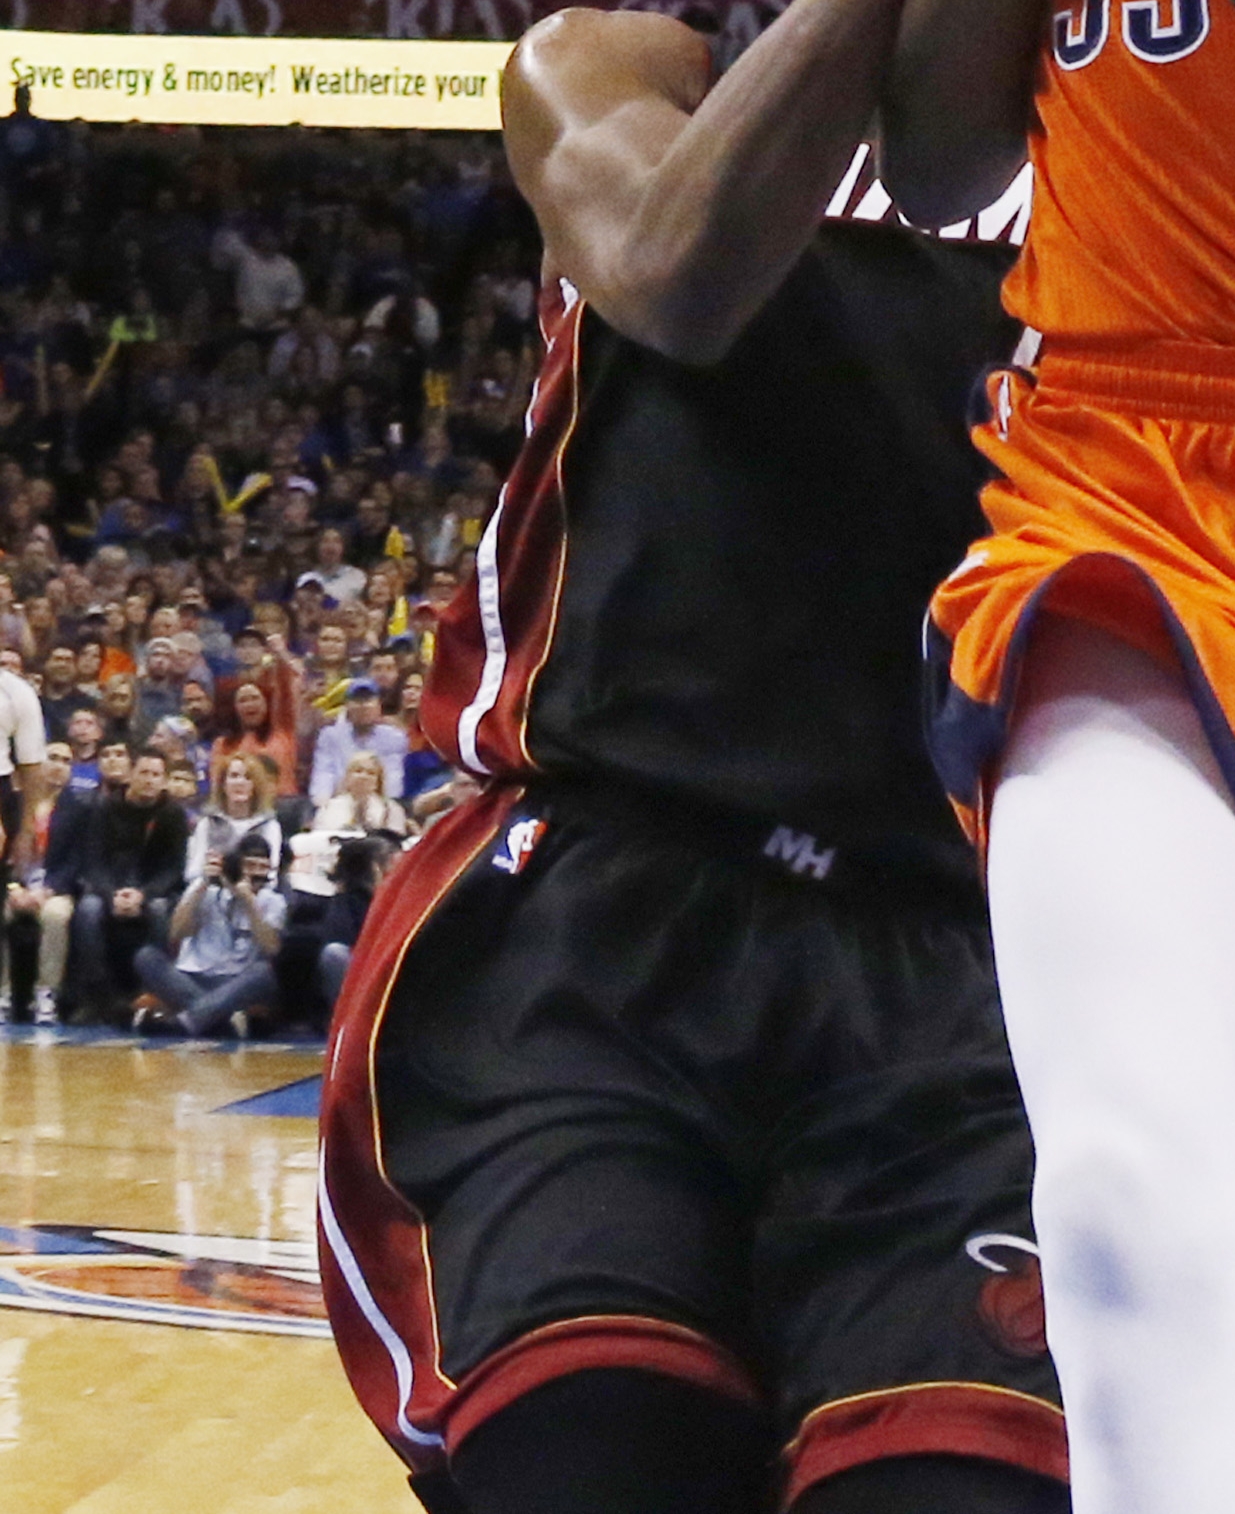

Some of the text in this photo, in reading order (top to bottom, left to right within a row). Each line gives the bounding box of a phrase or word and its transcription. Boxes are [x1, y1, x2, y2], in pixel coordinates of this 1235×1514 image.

[11, 57, 64, 88] Save
[72, 64, 154, 96] energy
[162, 62, 178, 92] &
[186, 66, 276, 98] money!
[291, 64, 426, 96] Weatherize
[434, 73, 487, 102] your
